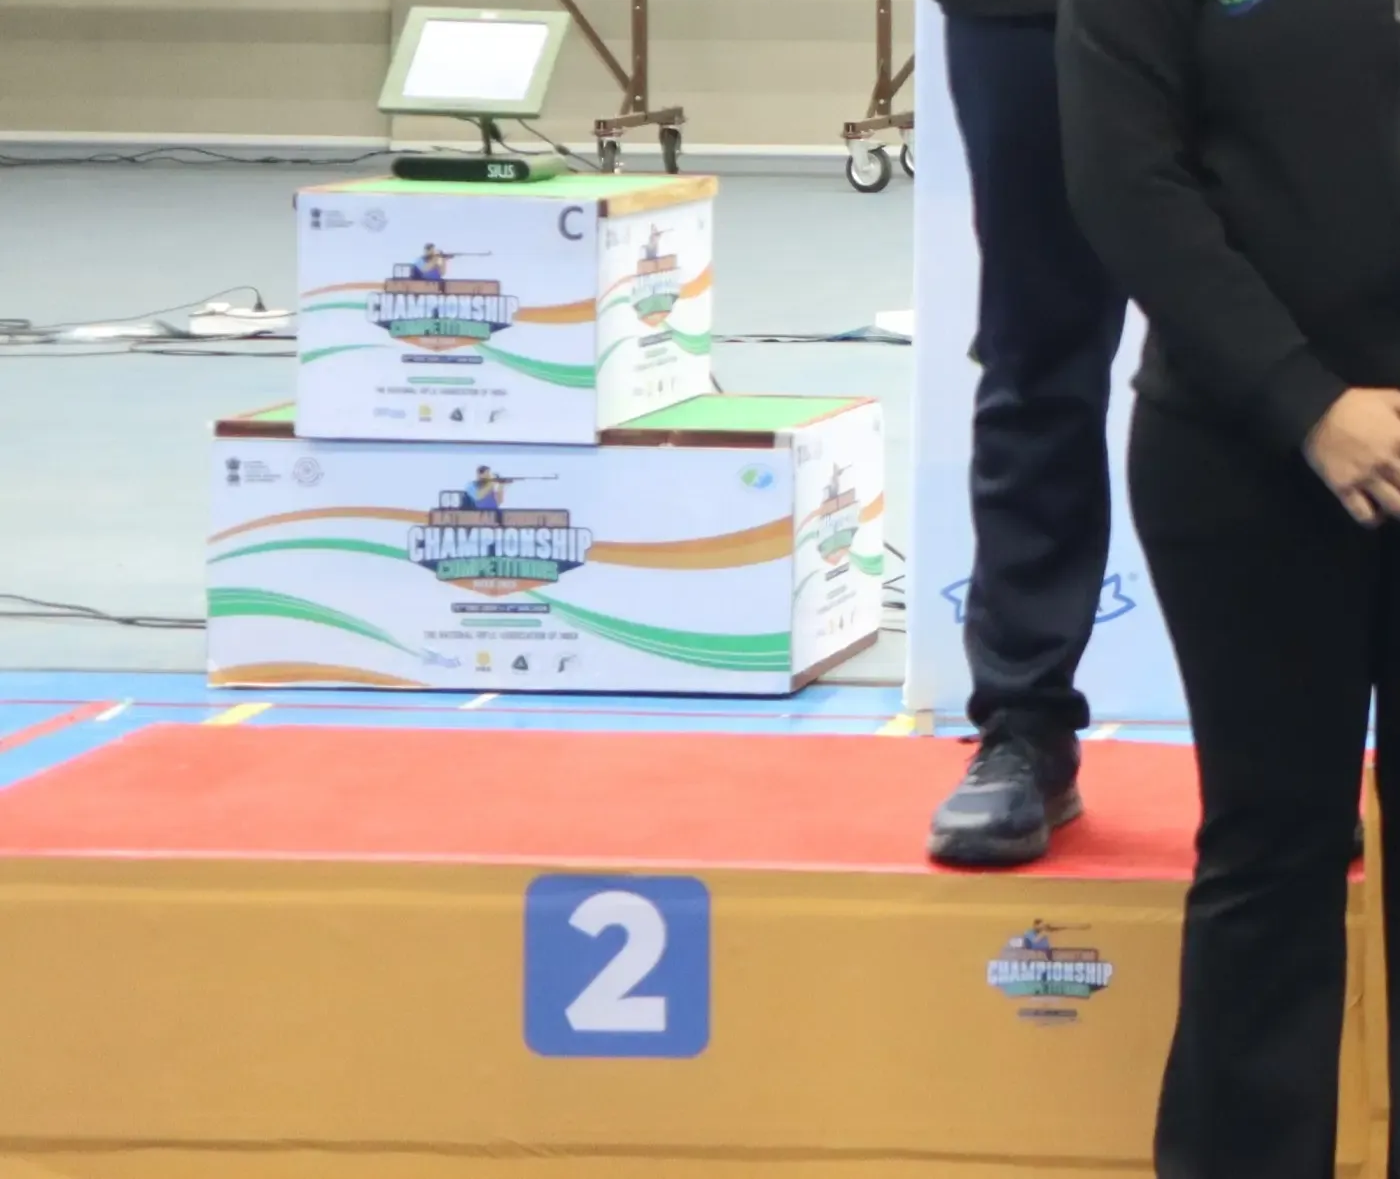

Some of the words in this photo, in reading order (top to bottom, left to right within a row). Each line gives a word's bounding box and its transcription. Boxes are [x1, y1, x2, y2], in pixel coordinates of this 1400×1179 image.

[558, 205, 584, 241] C
[408, 526, 593, 562] CHAMPIONSHIP
[564, 891, 667, 1031] 2
